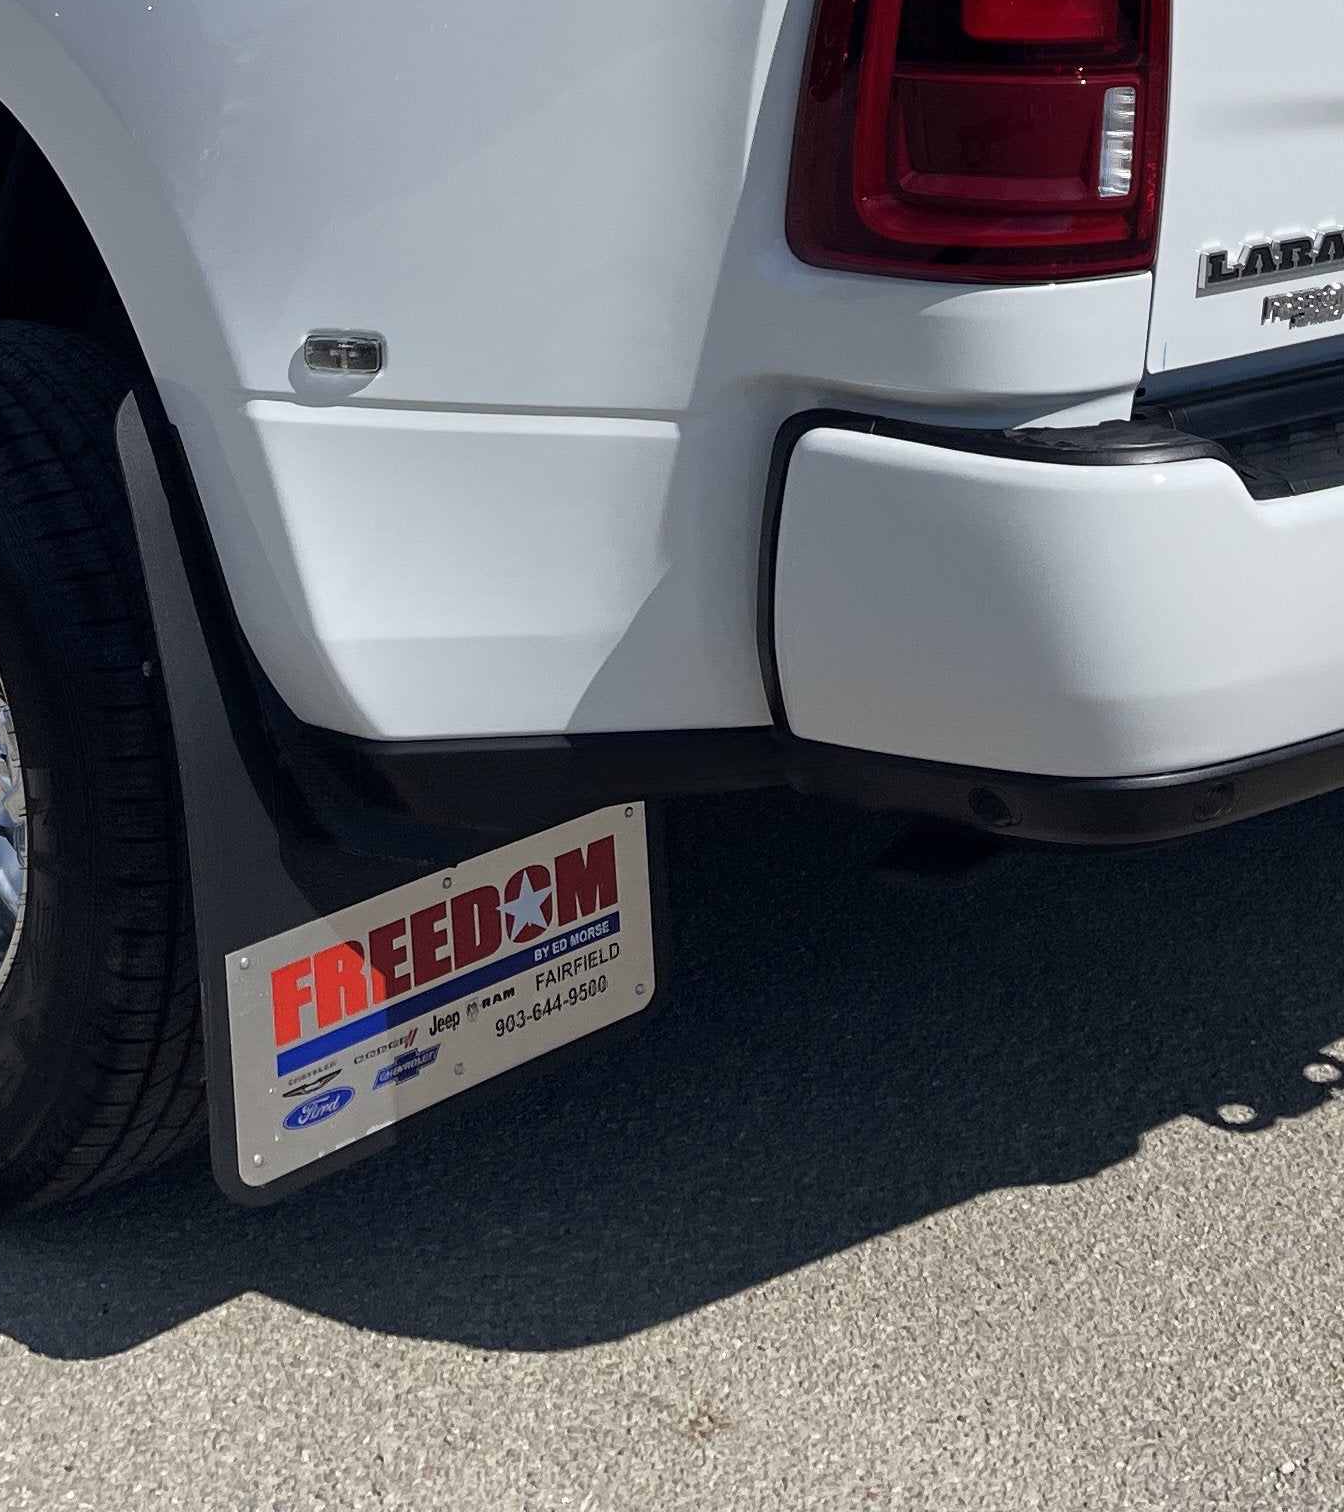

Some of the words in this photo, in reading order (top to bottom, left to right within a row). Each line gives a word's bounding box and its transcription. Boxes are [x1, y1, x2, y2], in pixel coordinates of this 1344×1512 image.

[270, 834, 619, 1048] FREEDOM
[534, 946, 550, 962] BY
[552, 939, 568, 954] ED
[569, 920, 611, 948] MORSE
[535, 941, 621, 992] FAIRFIELD
[481, 985, 516, 1010] RAM
[495, 974, 609, 1038] 903-644-9500
[429, 1010, 461, 1037] Jeep
[297, 1093, 340, 1125] Ford
